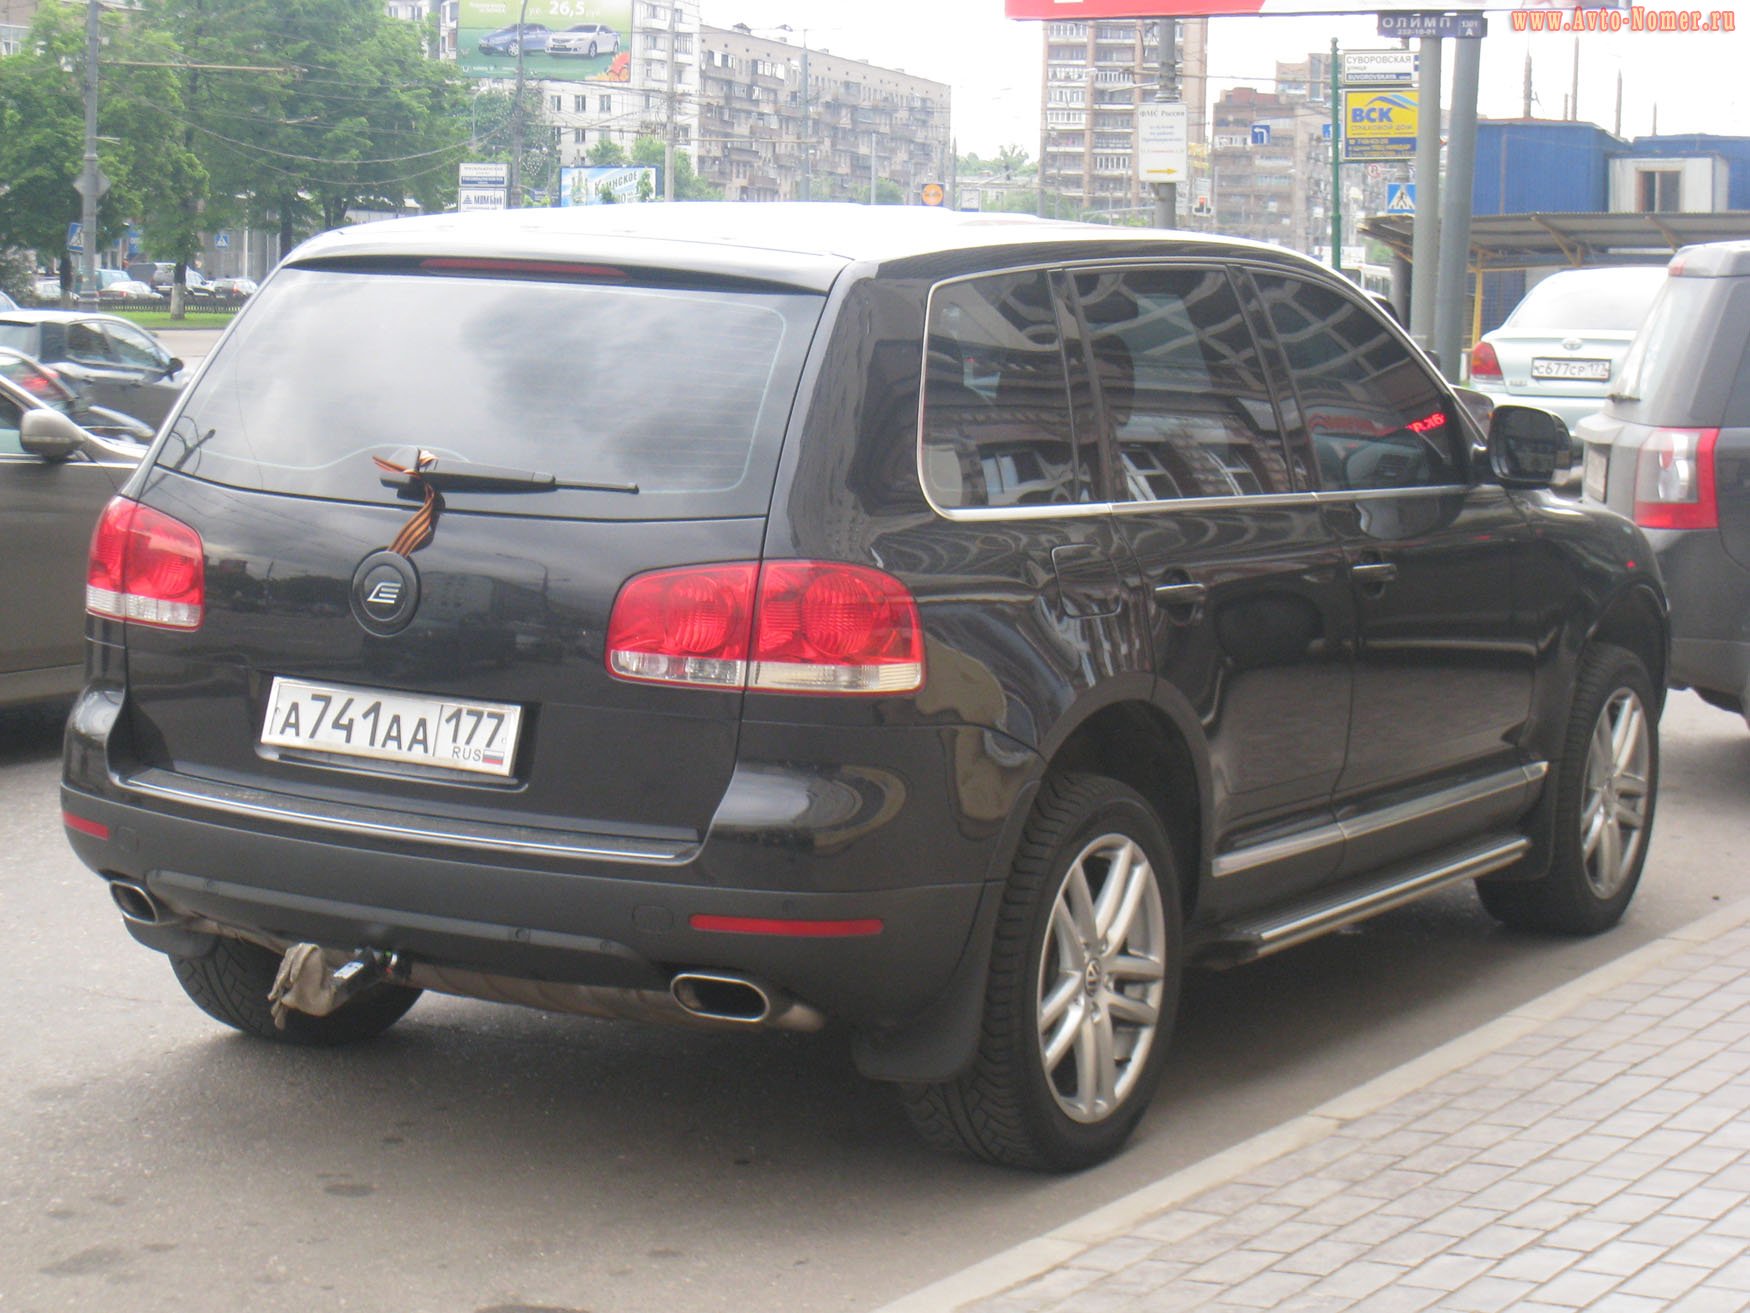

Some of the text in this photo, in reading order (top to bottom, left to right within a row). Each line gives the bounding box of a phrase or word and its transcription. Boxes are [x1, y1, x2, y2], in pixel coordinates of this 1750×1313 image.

[1382, 17, 1451, 28] ОЛИМП
[1346, 56, 1412, 64] СУВОРОВСКАЯ
[1352, 107, 1393, 122] ВСК
[279, 693, 429, 754] А741АА
[445, 708, 506, 748] 177
[451, 747, 482, 762] RUS
